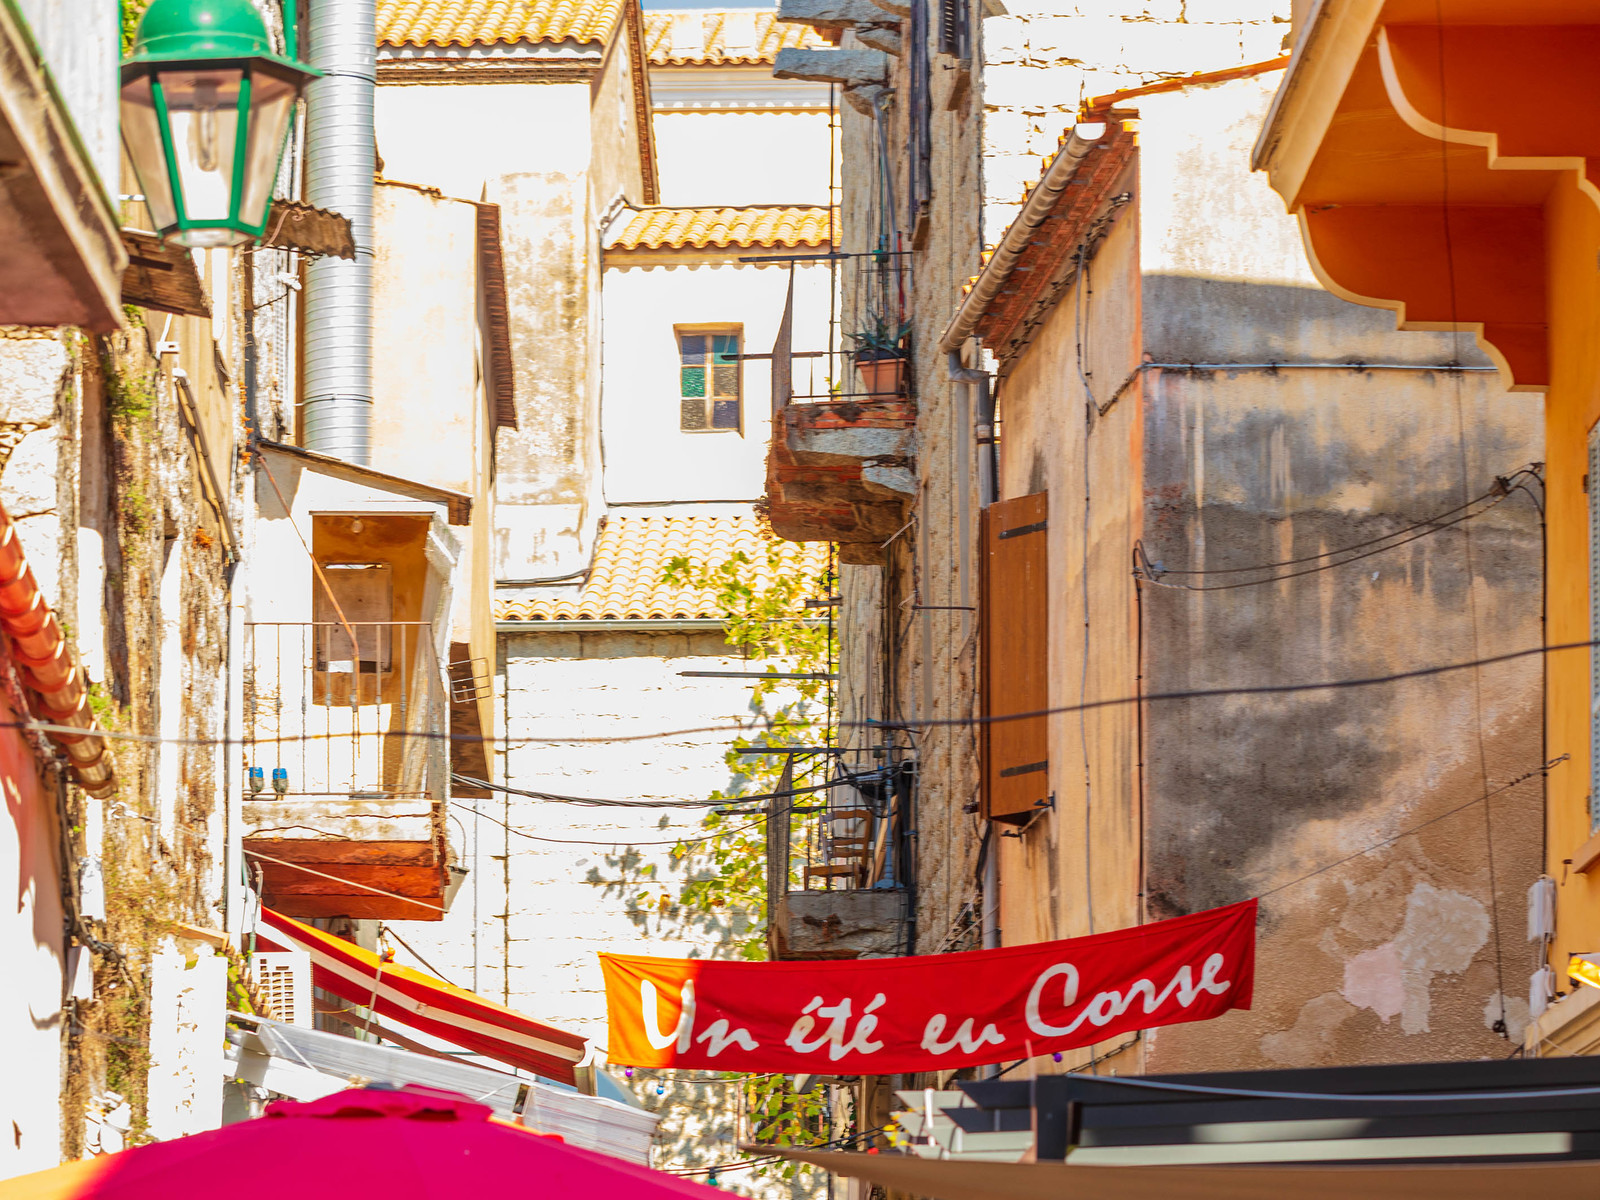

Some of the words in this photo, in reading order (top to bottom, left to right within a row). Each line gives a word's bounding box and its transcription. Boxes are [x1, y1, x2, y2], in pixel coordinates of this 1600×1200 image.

[640, 978, 759, 1057] Un
[785, 992, 885, 1061] été
[1023, 952, 1232, 1038] Corse
